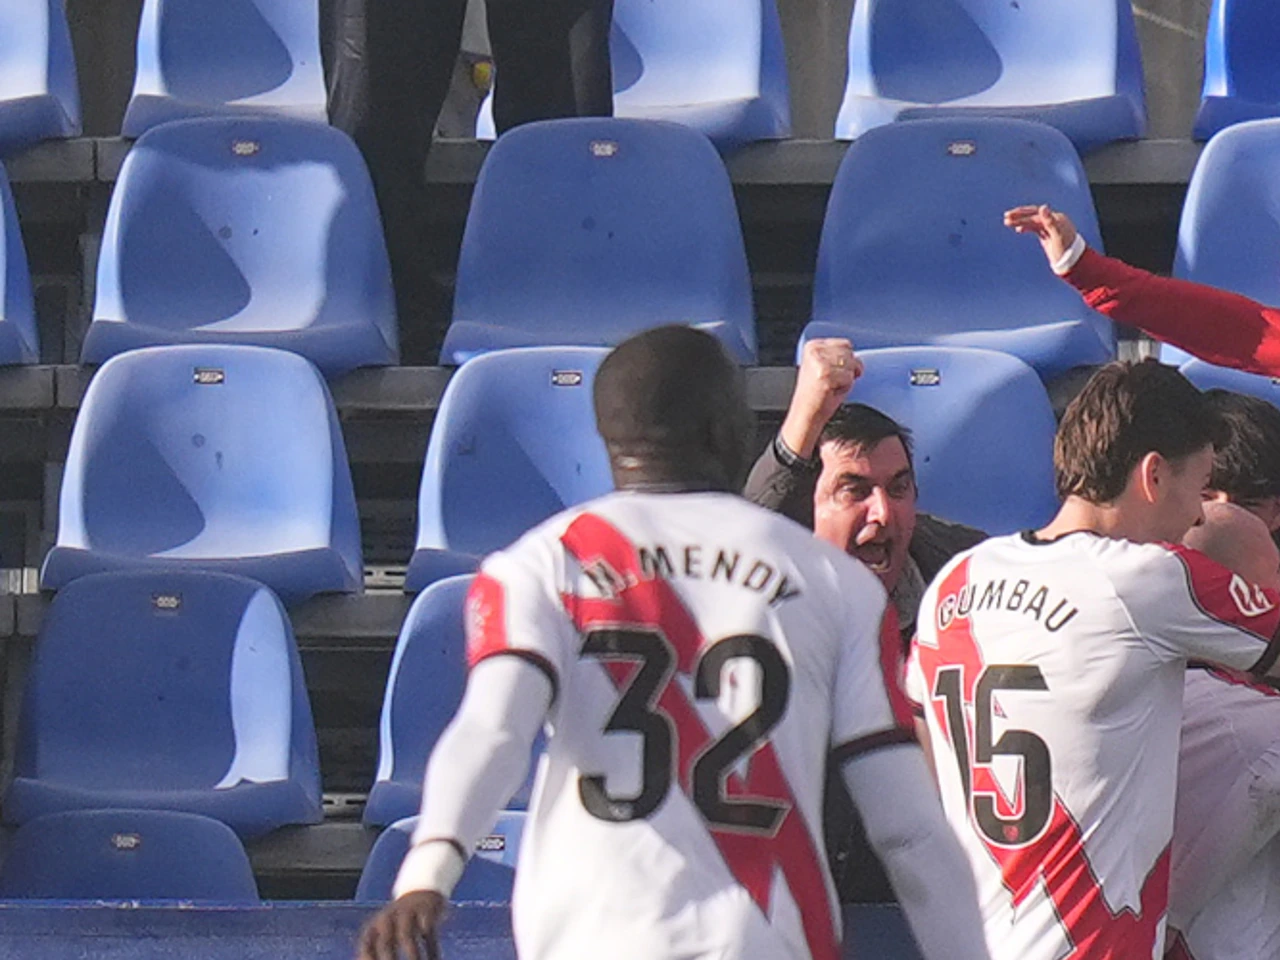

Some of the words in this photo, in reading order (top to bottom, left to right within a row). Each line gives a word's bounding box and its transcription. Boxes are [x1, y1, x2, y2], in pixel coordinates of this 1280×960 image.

[938, 580, 1079, 633] GUMBAU
[578, 625, 791, 833] 32
[934, 664, 1053, 846] 15
